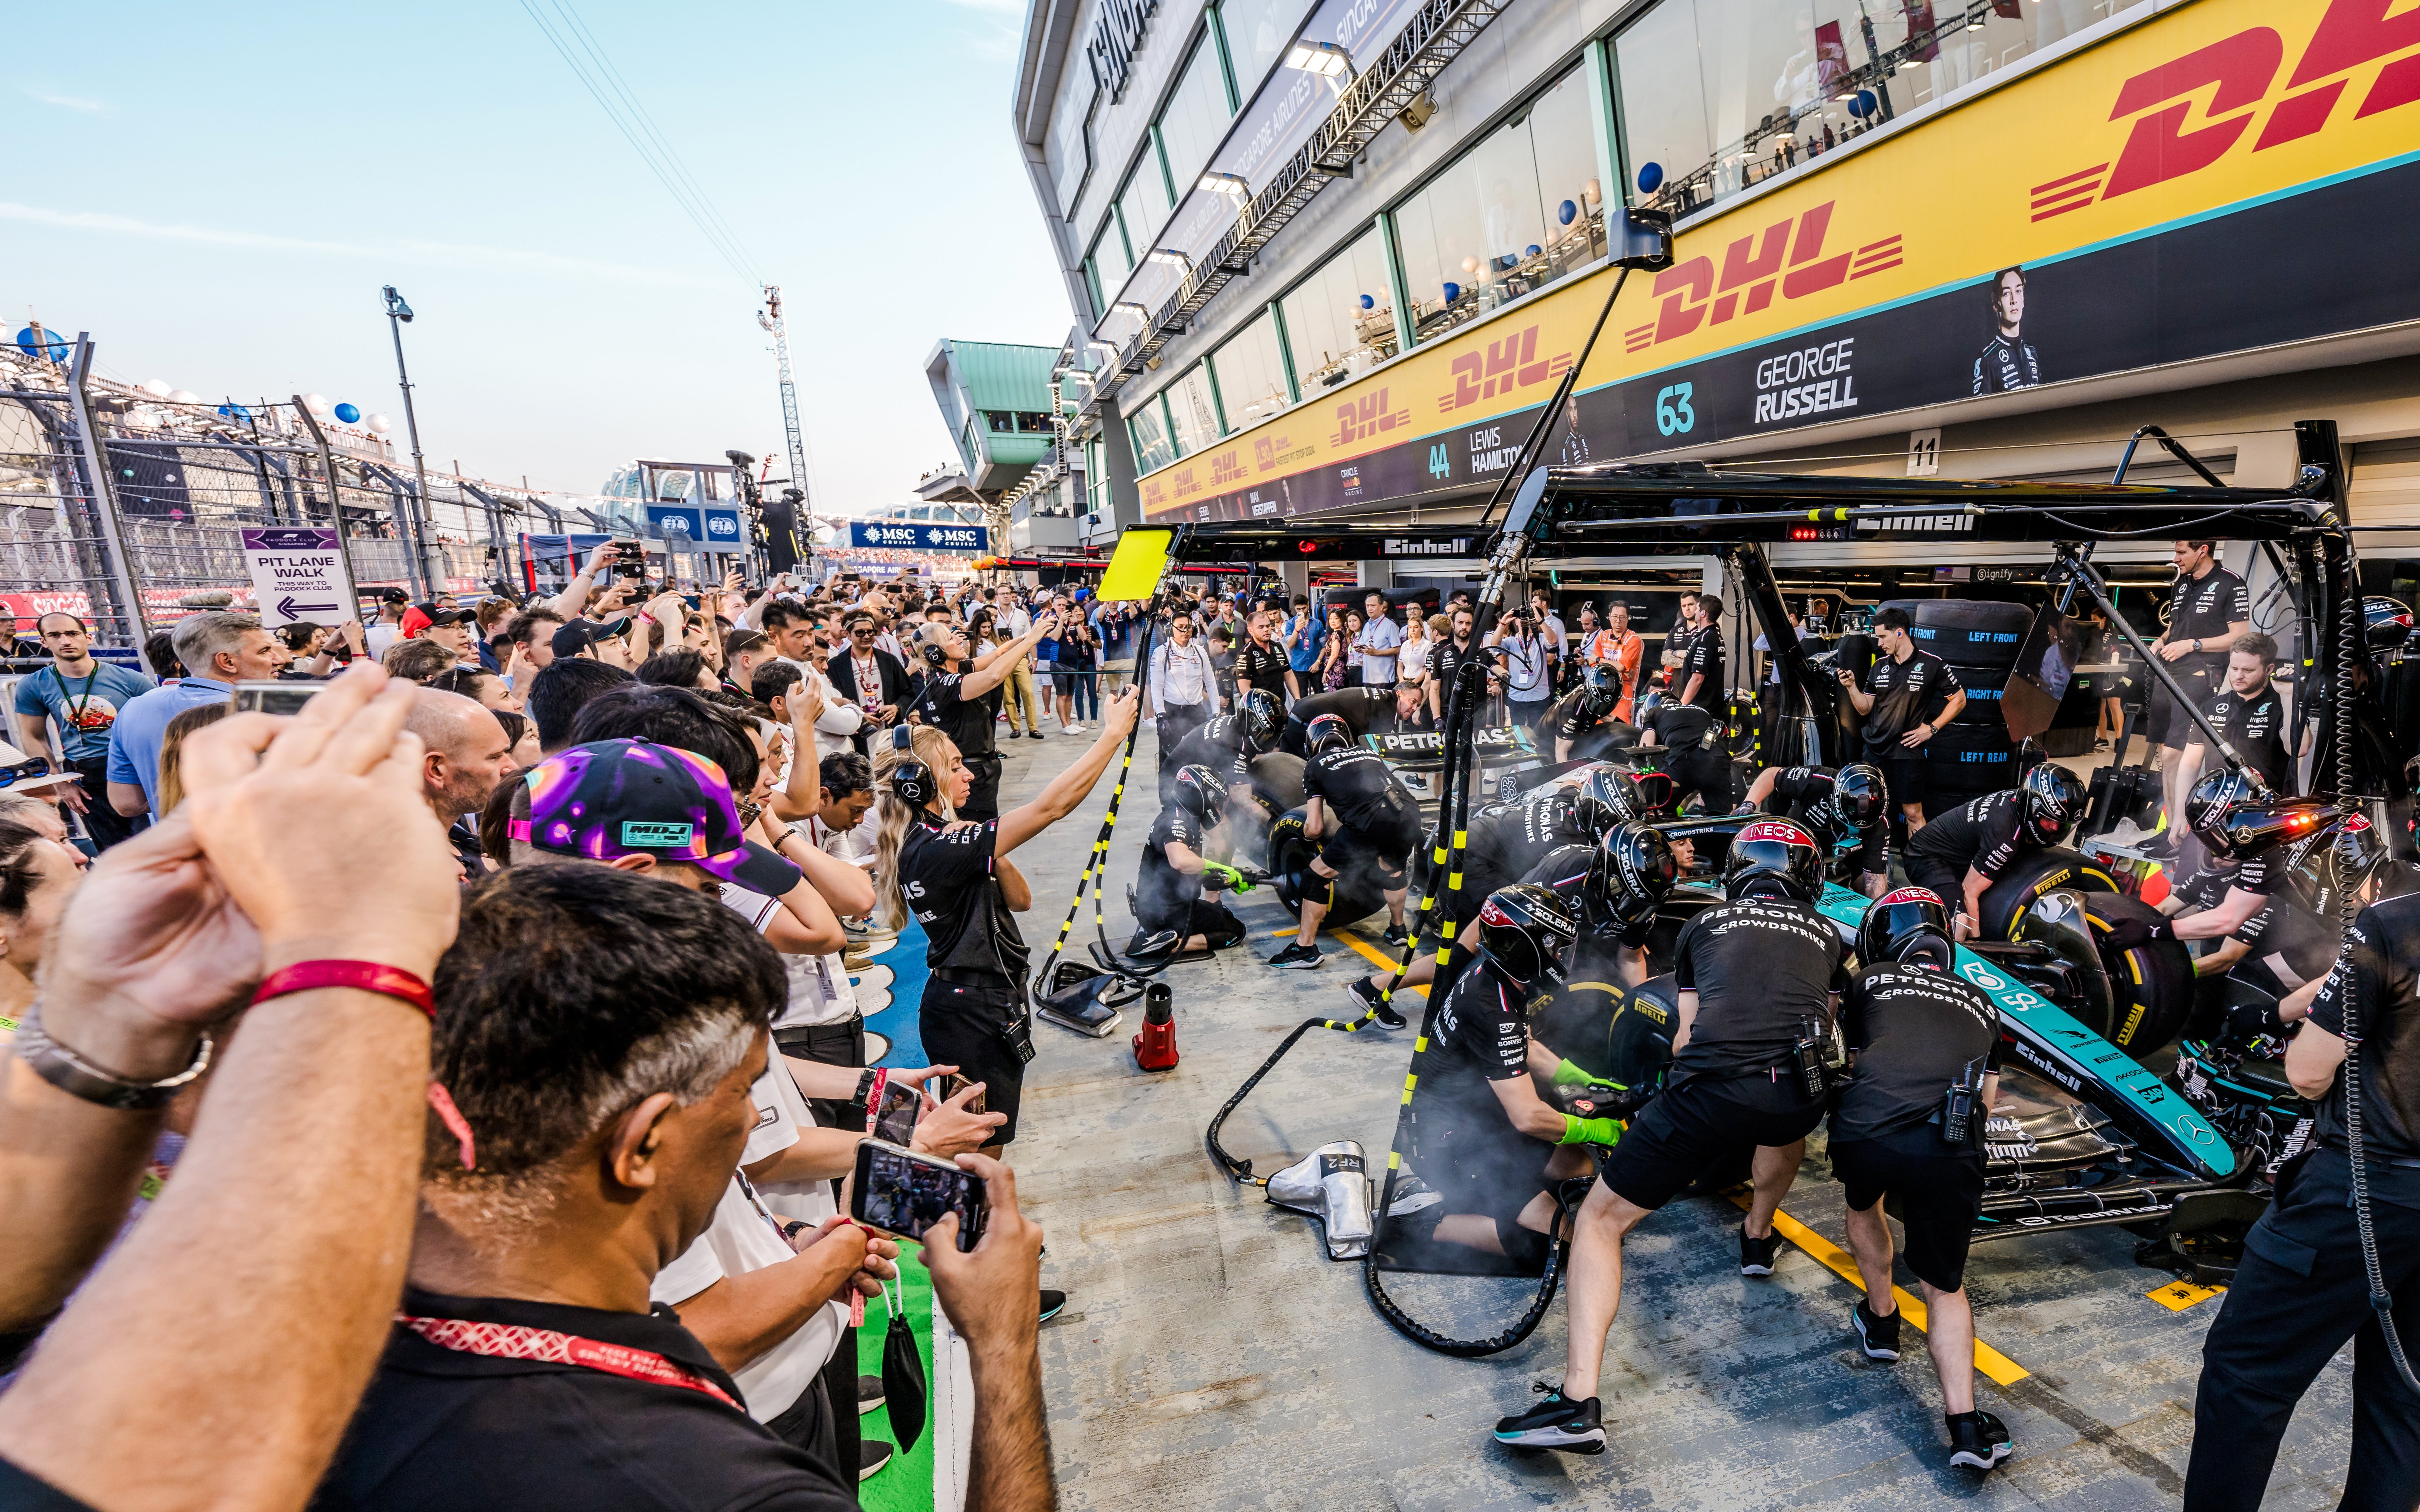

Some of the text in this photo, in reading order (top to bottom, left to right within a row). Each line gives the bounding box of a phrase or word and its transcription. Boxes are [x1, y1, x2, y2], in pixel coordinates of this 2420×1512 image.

[1273, 71, 1310, 137] AIRLINES
[1652, 200, 1853, 345] DHL
[1451, 324, 1550, 409] DHL
[1756, 337, 1854, 389] GEORGE
[1656, 381, 1694, 436] 63
[1754, 376, 1858, 424] RUSSELL
[1336, 387, 1397, 446] DHL
[1275, 436, 1290, 452] DHL
[1470, 426, 1501, 452] LEWIS
[1276, 452, 1289, 466] FASTEST
[1296, 448, 1305, 459] STOP
[1429, 443, 1450, 479] 44
[1913, 438, 1936, 466] 11
[1213, 450, 1243, 486] DHL
[1340, 466, 1358, 478] ORACLE
[1174, 468, 1196, 498] DHL
[1145, 481, 1163, 507] DHL
[1249, 491, 1260, 504] MAX
[1251, 500, 1278, 516] VERSTAPPEN
[881, 528, 976, 542] MSC MSC
[1385, 539, 1466, 553] Einhell
[258, 557, 335, 566] PIT LANE
[274, 568, 325, 578] WALK
[1918, 629, 1936, 640] FRONT
[1969, 632, 2018, 643] LEFT FRONT
[1967, 689, 1991, 699] RIGHT
[1254, 702, 1268, 725] SOLERA
[1386, 728, 1507, 750] PETRAS
[1318, 748, 1380, 767] PETRONAS
[1332, 756, 1382, 768] CROWDSTRIKE
[1961, 752, 2007, 762] LEFT REAR
[1204, 775, 1226, 795] SOLERA
[1607, 781, 1626, 815] SOLERA
[1833, 782, 1842, 814] SOLERA
[2041, 779, 2057, 812] SOLERA
[2204, 787, 2232, 824] SOLERA
[1817, 809, 1828, 819] UBS
[629, 825, 687, 834] MDJ
[1274, 818, 1302, 832] ZERO
[1671, 827, 1714, 837] CROWDSTRIKE
[1749, 825, 1795, 840] INEOS
[2028, 820, 2046, 844] Einhell
[2000, 843, 2012, 852] SAP
[2289, 832, 2319, 867] SOLERA
[1621, 854, 1639, 894] SOLERA
[2034, 869, 2071, 896] PIRELLI
[2240, 875, 2259, 883] AMD
[1895, 889, 1939, 901] INEOS
[2316, 887, 2330, 915] Einhell
[1535, 907, 1572, 933] SOLERA
[1700, 907, 1833, 937] PETRONAS
[2243, 921, 2264, 931] PIRELLI
[1719, 919, 1826, 952] CROWDSTRIKE
[2239, 926, 2259, 936] AMD
[1865, 974, 1996, 1021] PETRONAS
[2000, 993, 2038, 1012] 50
[1634, 997, 1668, 1025] PIRELLI
[1881, 988, 1988, 1029] CROWDSTRIKE
[2117, 1002, 2146, 1046] PIRELLI
[1497, 1038, 1522, 1047] BONVOY
[2070, 1037, 2104, 1049] CROWDSTRIKE
[2015, 1041, 2082, 1092] Einhell
[2093, 1053, 2124, 1064] PIRELLI
[2115, 1068, 2148, 1083] AKKODIS
[2140, 1087, 2163, 1102] SAP
[1328, 1158, 1361, 1169] RF2
